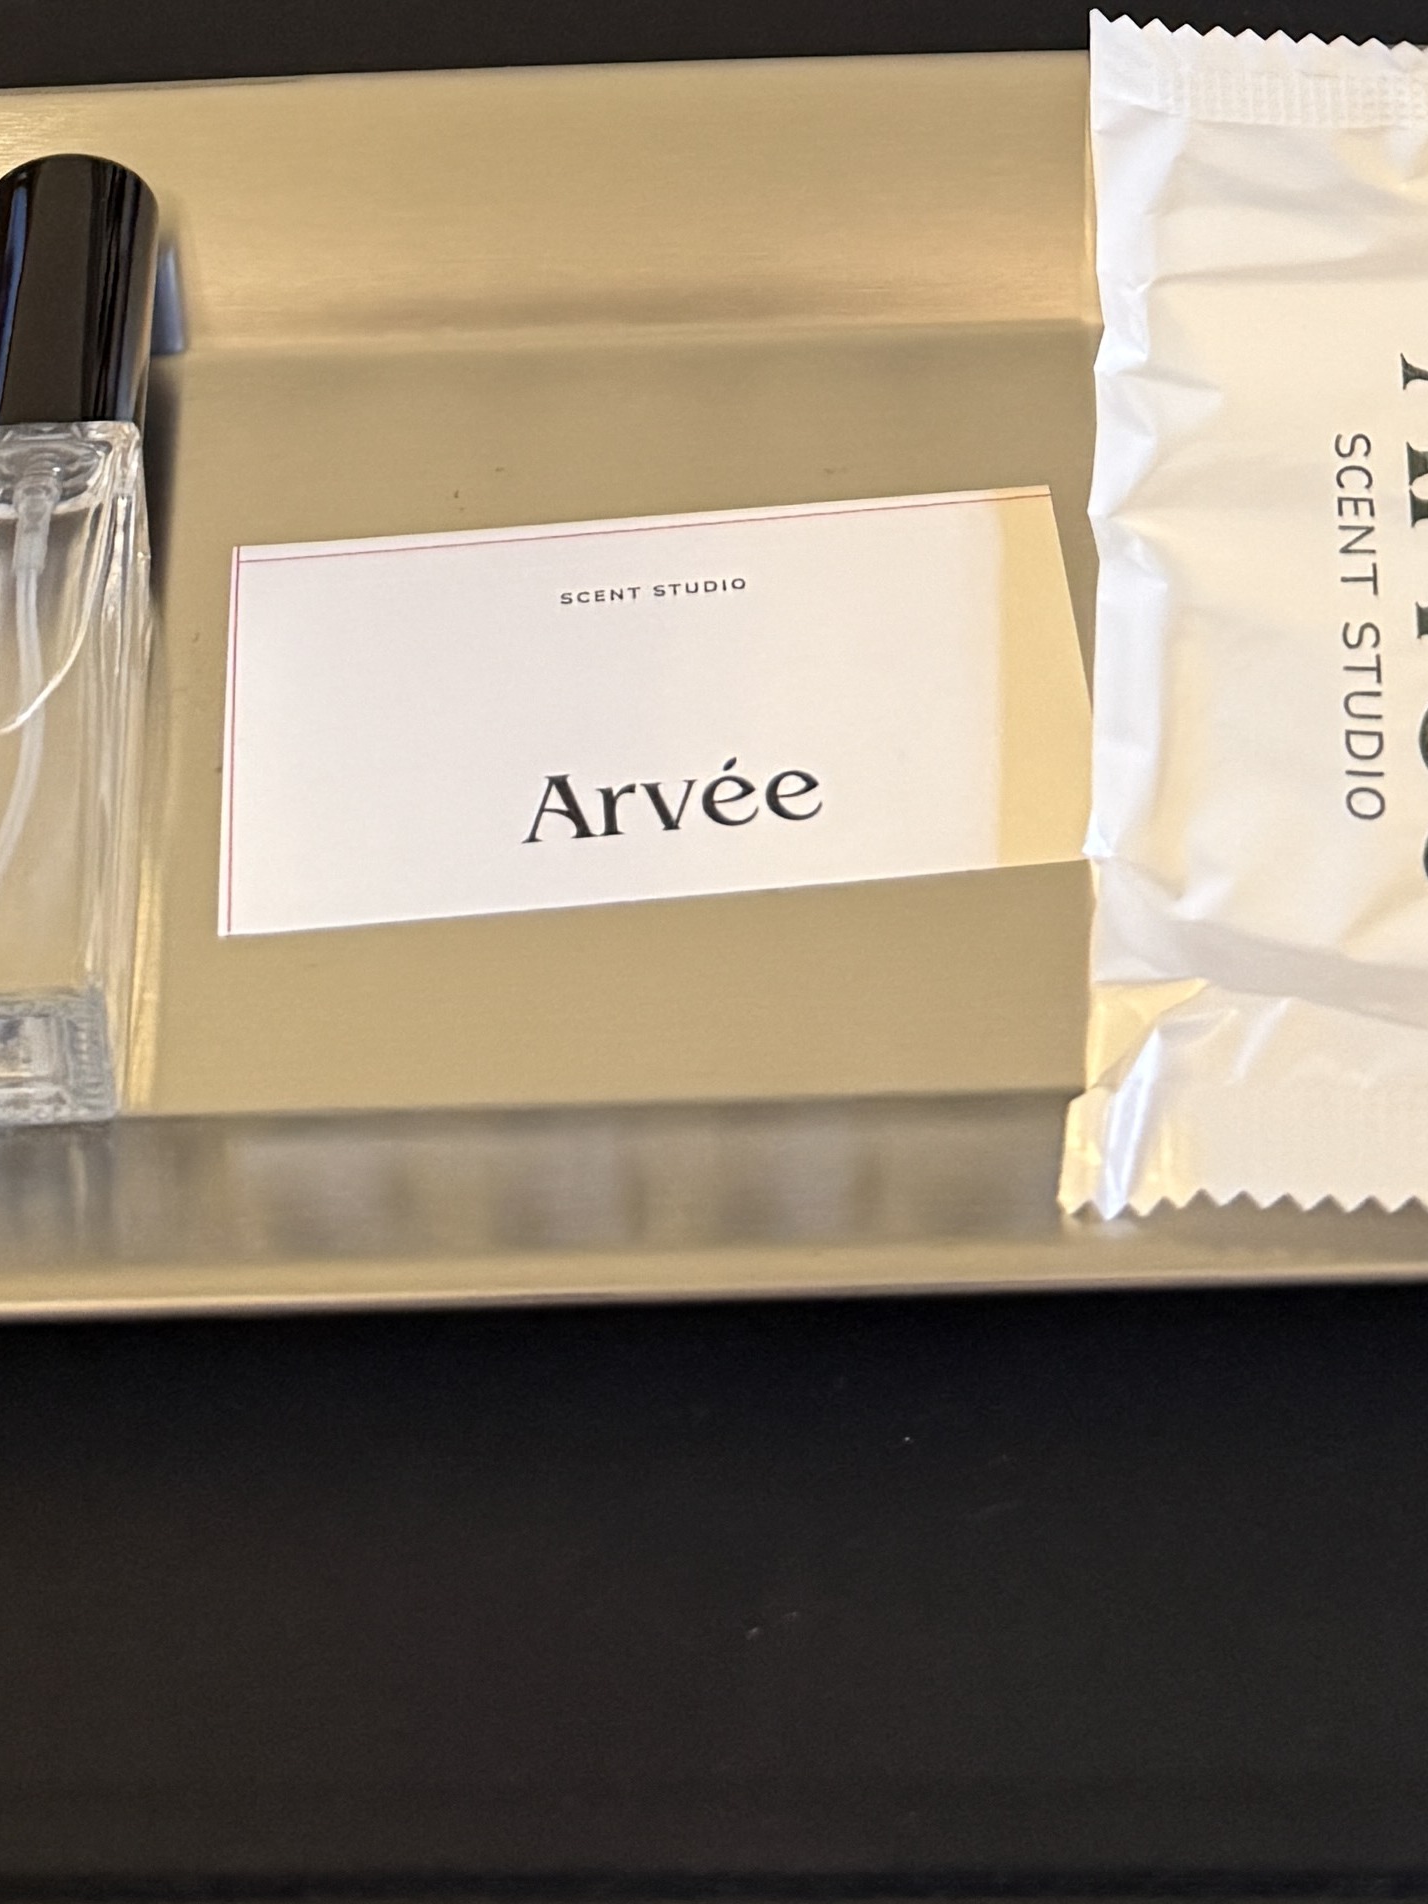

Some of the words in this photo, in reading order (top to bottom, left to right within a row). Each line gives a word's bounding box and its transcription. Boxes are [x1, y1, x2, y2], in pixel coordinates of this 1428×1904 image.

[1334, 432, 1379, 596] SCENT
[560, 586, 641, 605] SCENT
[652, 578, 747, 598] STUDIO
[1342, 622, 1386, 821] STUDIO
[521, 756, 822, 844] Arvée
